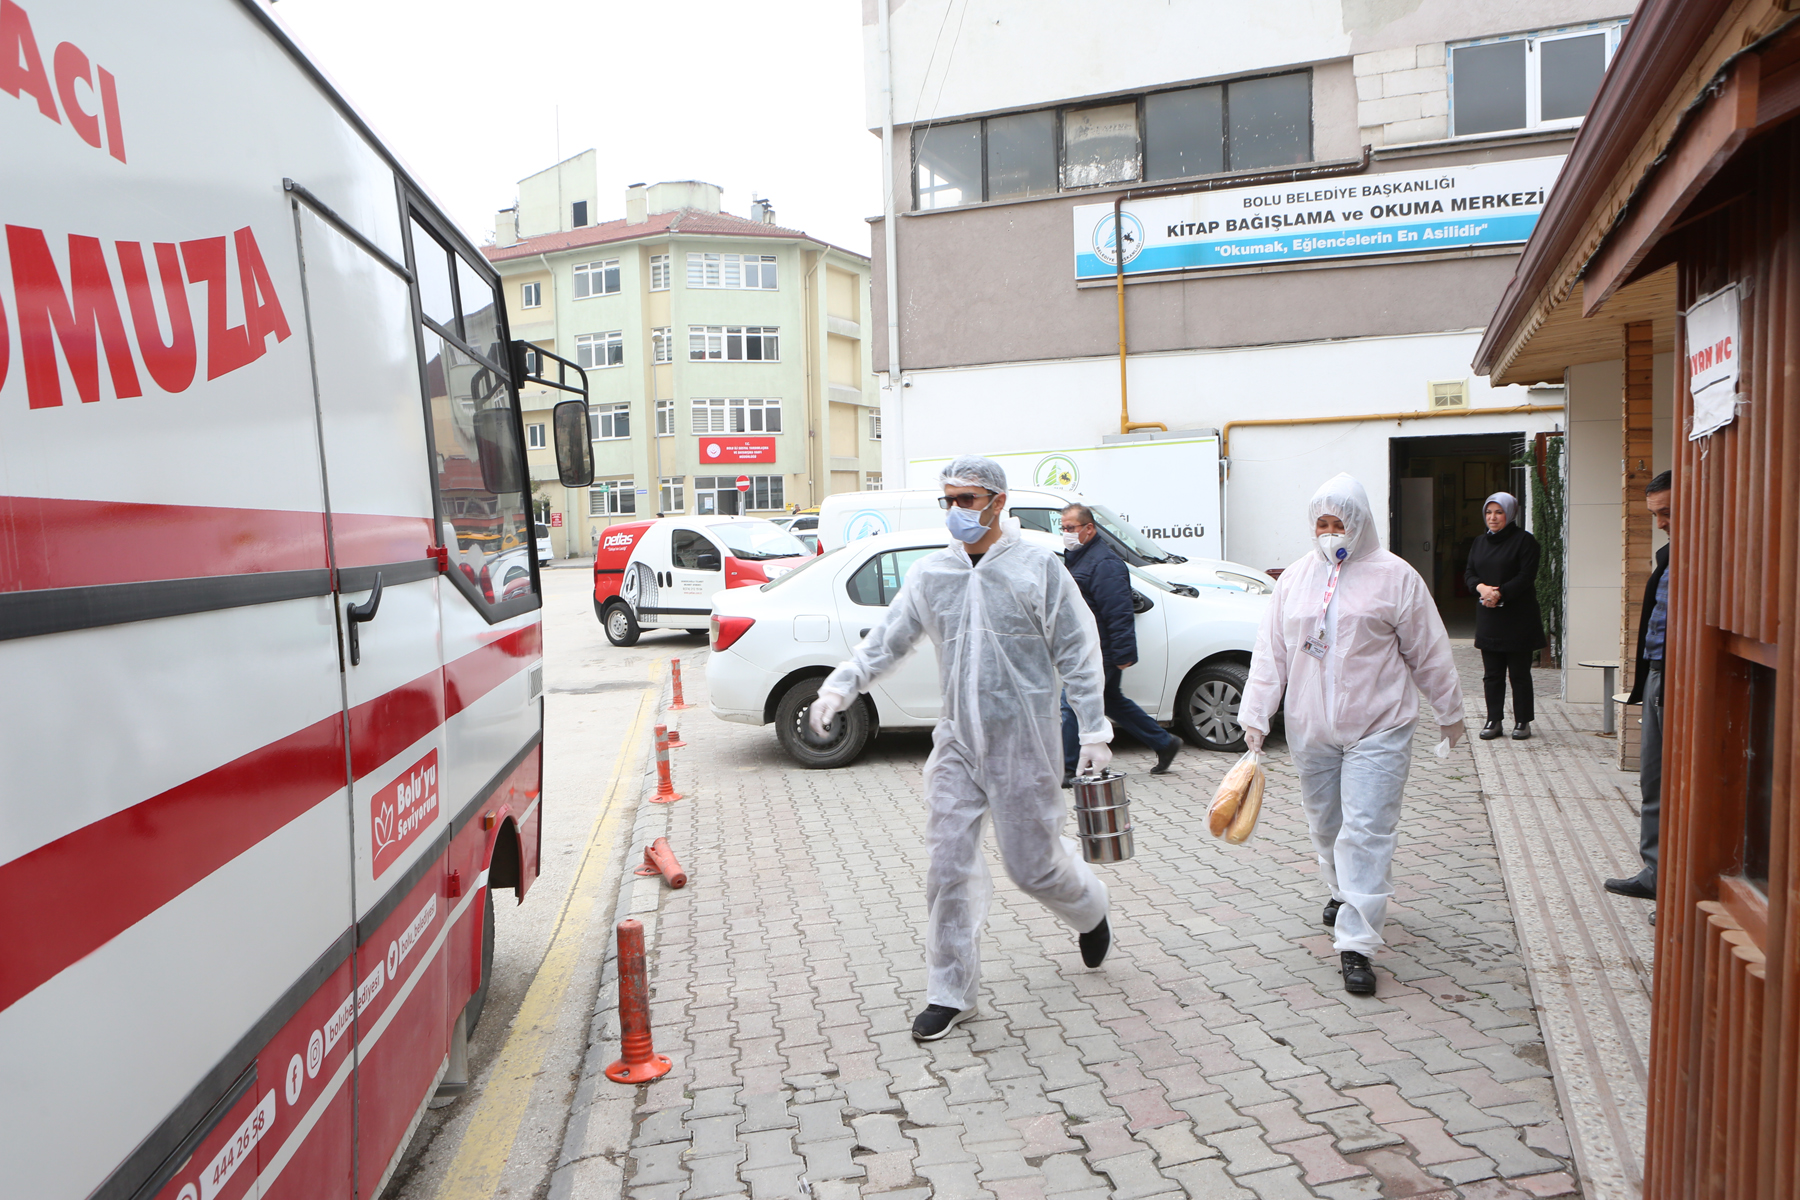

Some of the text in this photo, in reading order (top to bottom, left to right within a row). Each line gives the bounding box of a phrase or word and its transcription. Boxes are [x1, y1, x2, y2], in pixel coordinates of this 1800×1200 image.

[1167, 186, 1545, 238] KİTAP BAĞIŞLAMA ve OKUMA MERKEZİ
[1243, 175, 1455, 208] BOLU BELEDİYE BAŞKANLIĞI
[1214, 223, 1488, 257] "Okumak, Eğlencelerin En Asilidir"
[0, 224, 292, 410] MUZA
[1715, 336, 1732, 365] WC
[397, 763, 436, 815] Bolu'yu
[398, 792, 437, 841] Seviyorum
[212, 1109, 265, 1186] 444 26 58
